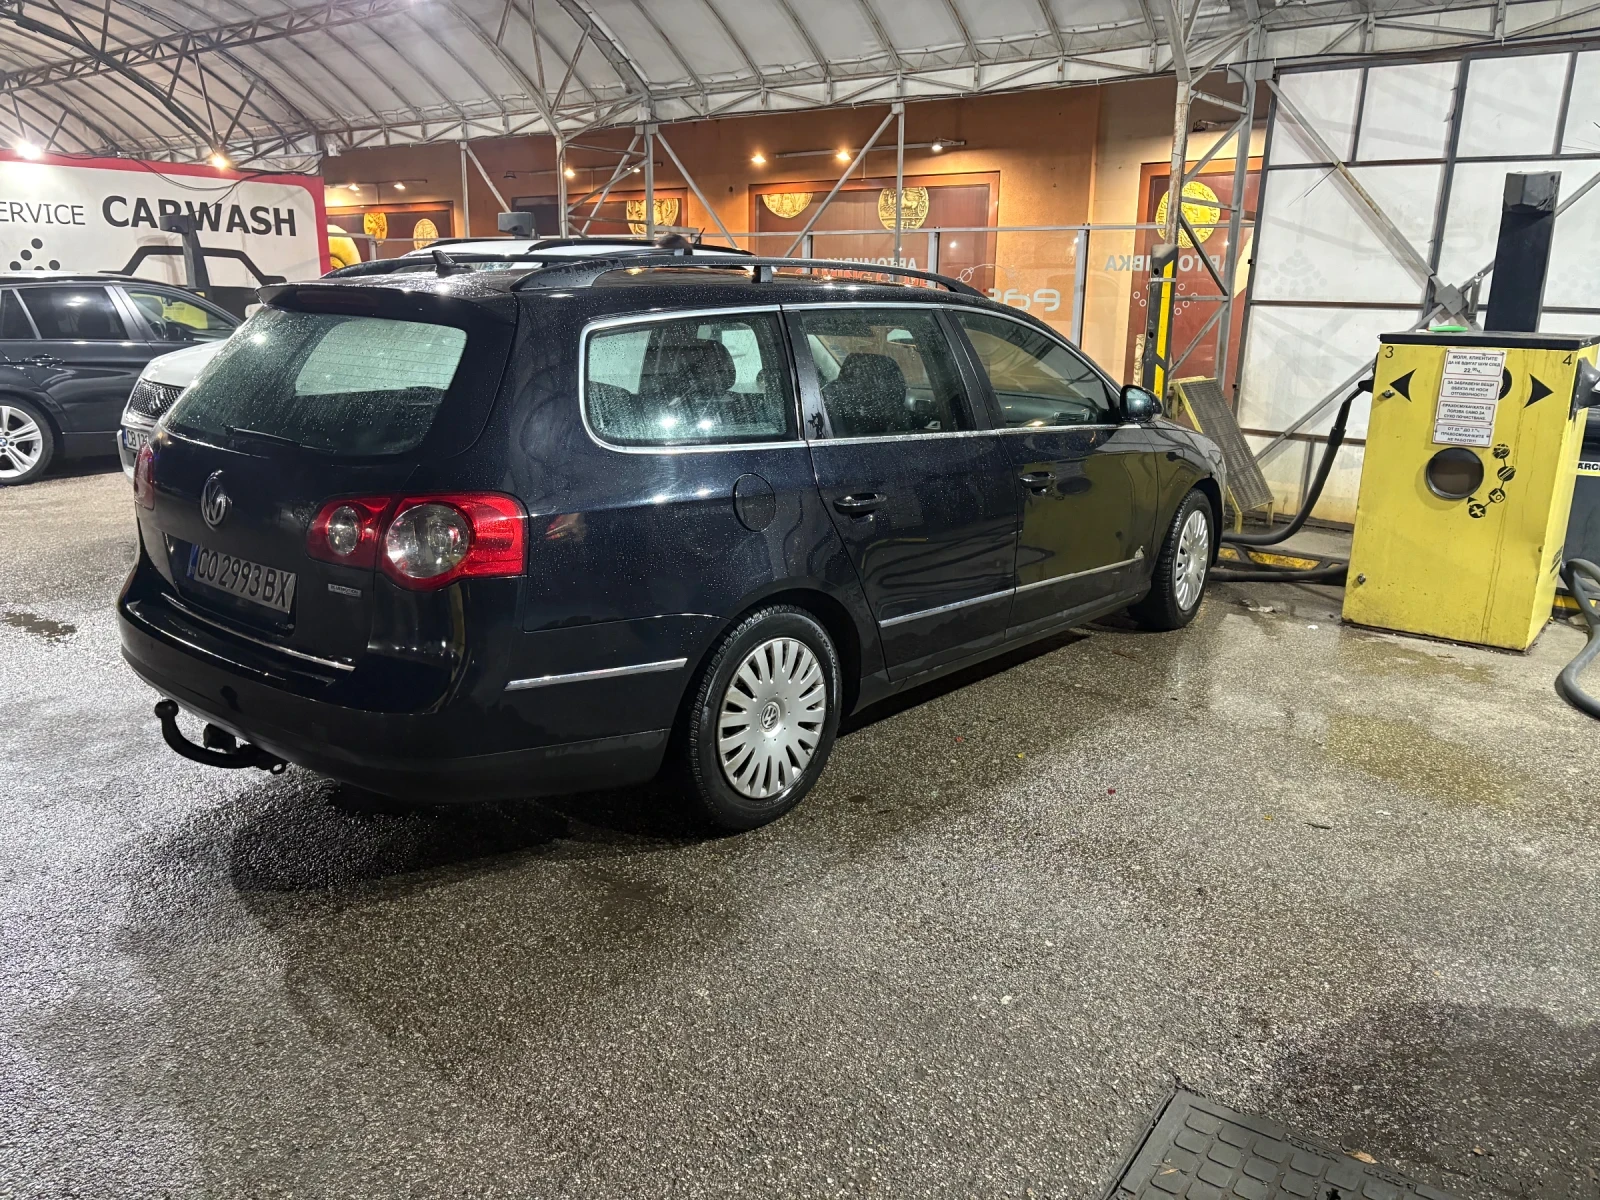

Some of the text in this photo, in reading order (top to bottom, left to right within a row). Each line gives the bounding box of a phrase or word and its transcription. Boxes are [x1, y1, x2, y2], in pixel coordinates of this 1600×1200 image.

[1385, 345, 1394, 359] 3
[1563, 353, 1572, 366] 4
[197, 549, 291, 608] CO 2993 BX
